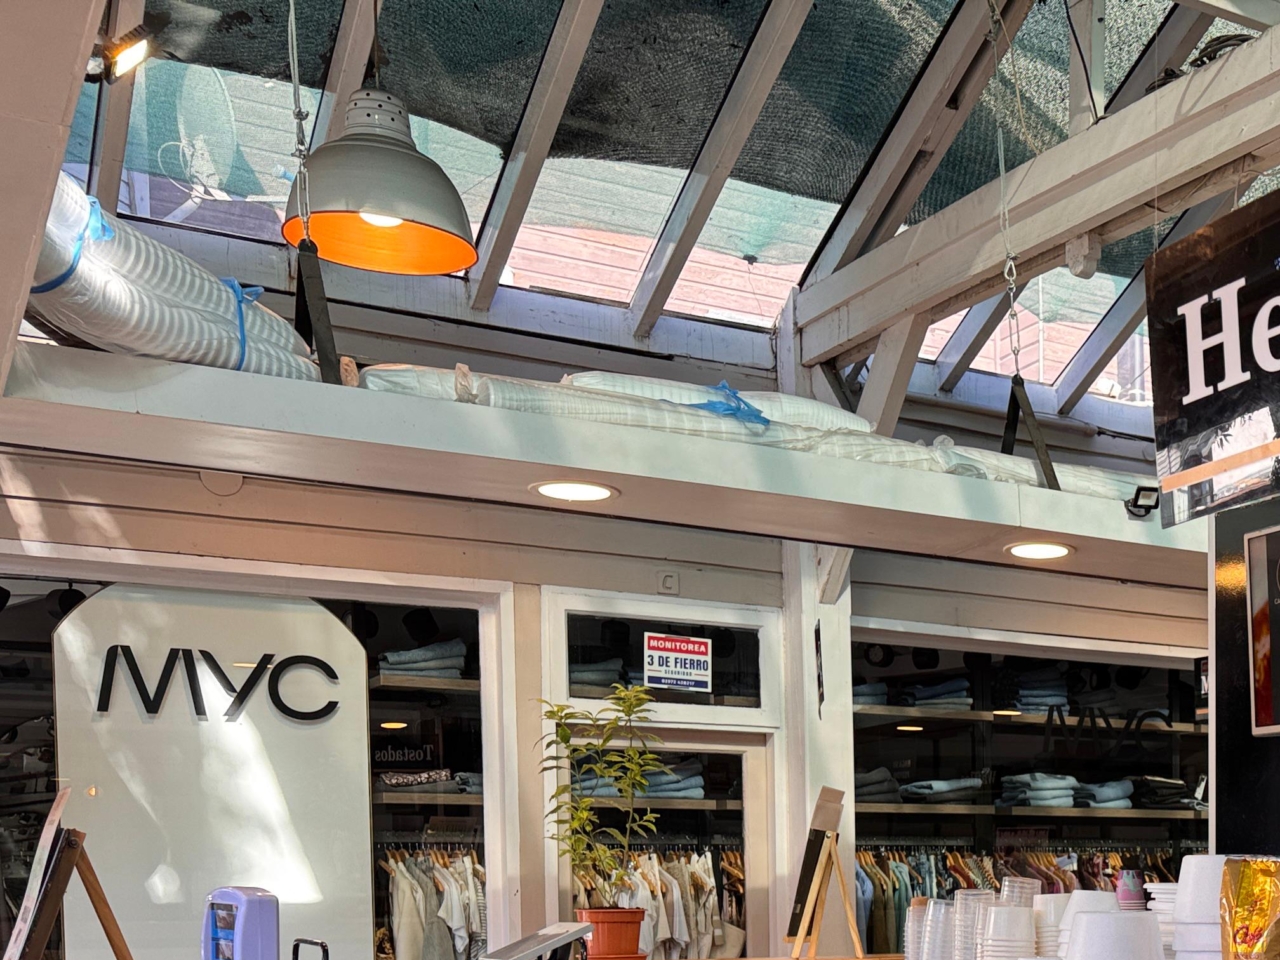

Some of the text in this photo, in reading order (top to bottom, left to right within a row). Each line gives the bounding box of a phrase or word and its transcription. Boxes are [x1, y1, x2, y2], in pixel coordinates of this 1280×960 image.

[650, 639, 706, 652] MONITOREA
[647, 655, 709, 671] 3 DE FIERRO
[97, 644, 339, 720] MYC
